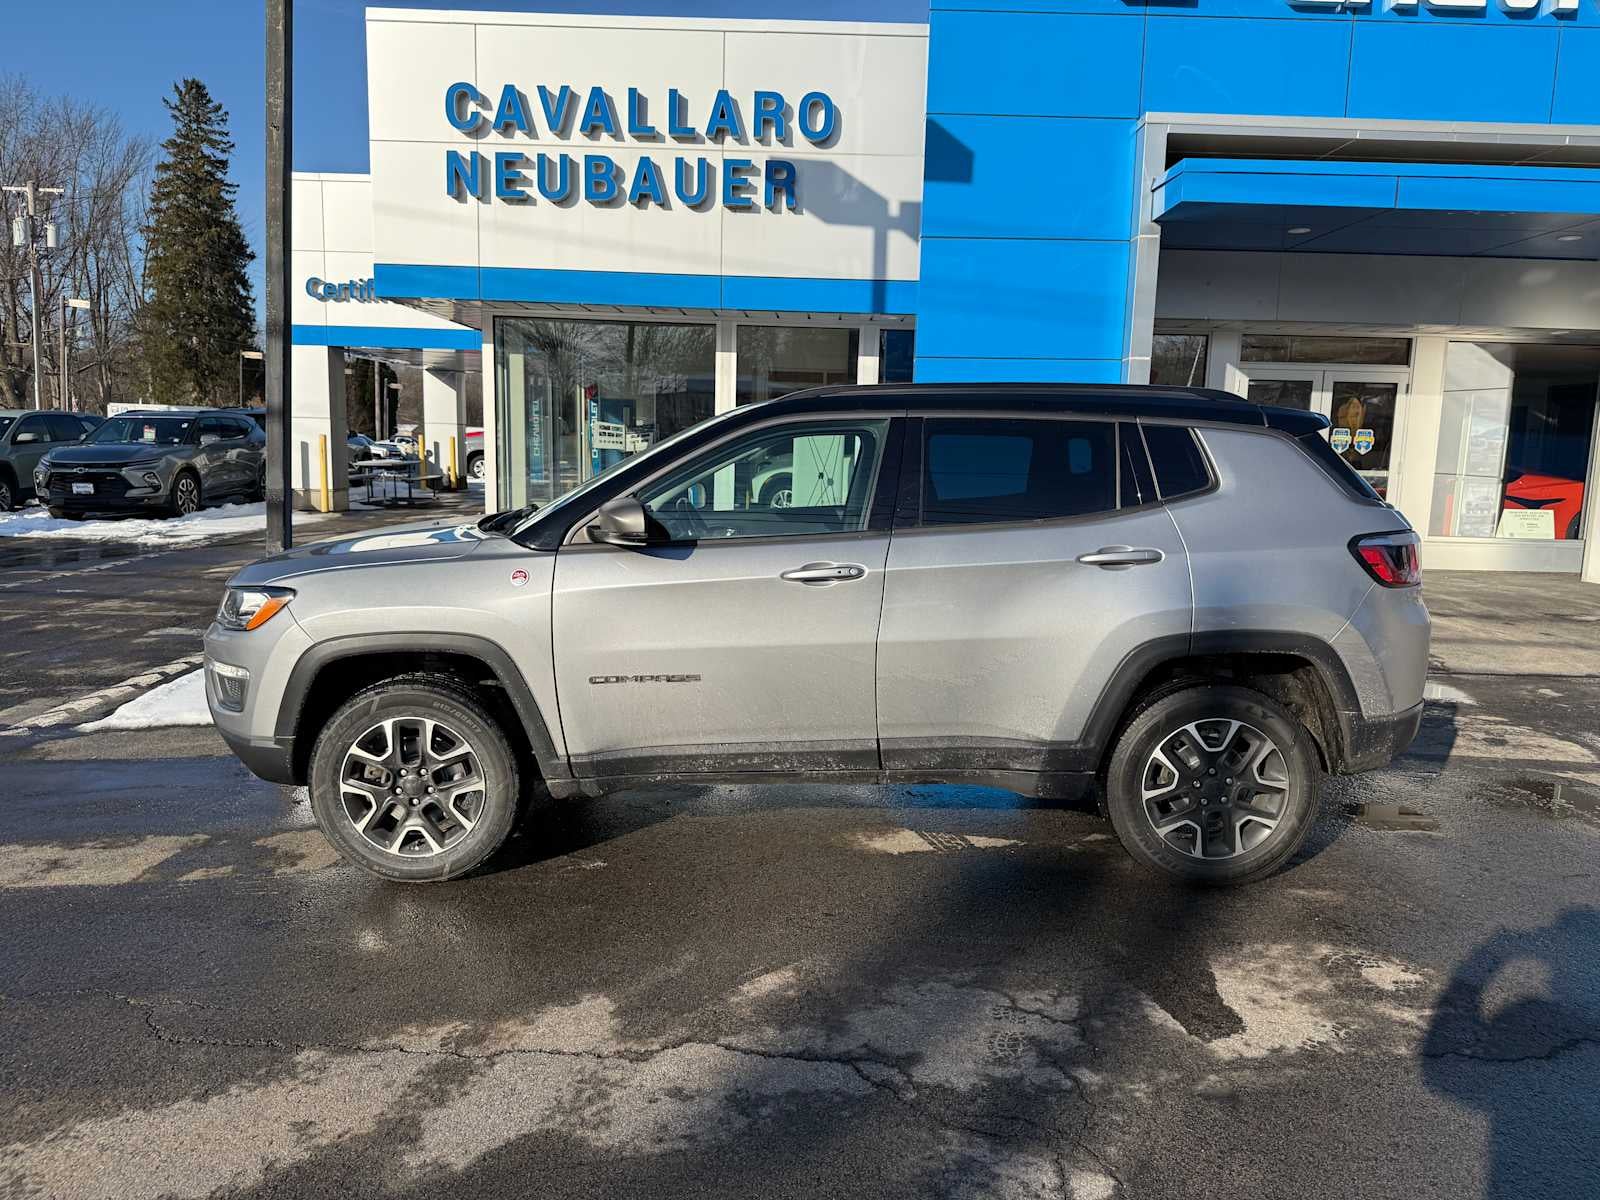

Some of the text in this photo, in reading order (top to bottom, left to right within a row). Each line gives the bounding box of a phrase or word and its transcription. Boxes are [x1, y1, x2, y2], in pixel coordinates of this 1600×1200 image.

[445, 81, 837, 146] CAVALLARO
[446, 150, 799, 210] NEUBAUER
[588, 674, 702, 685] COMPASS
